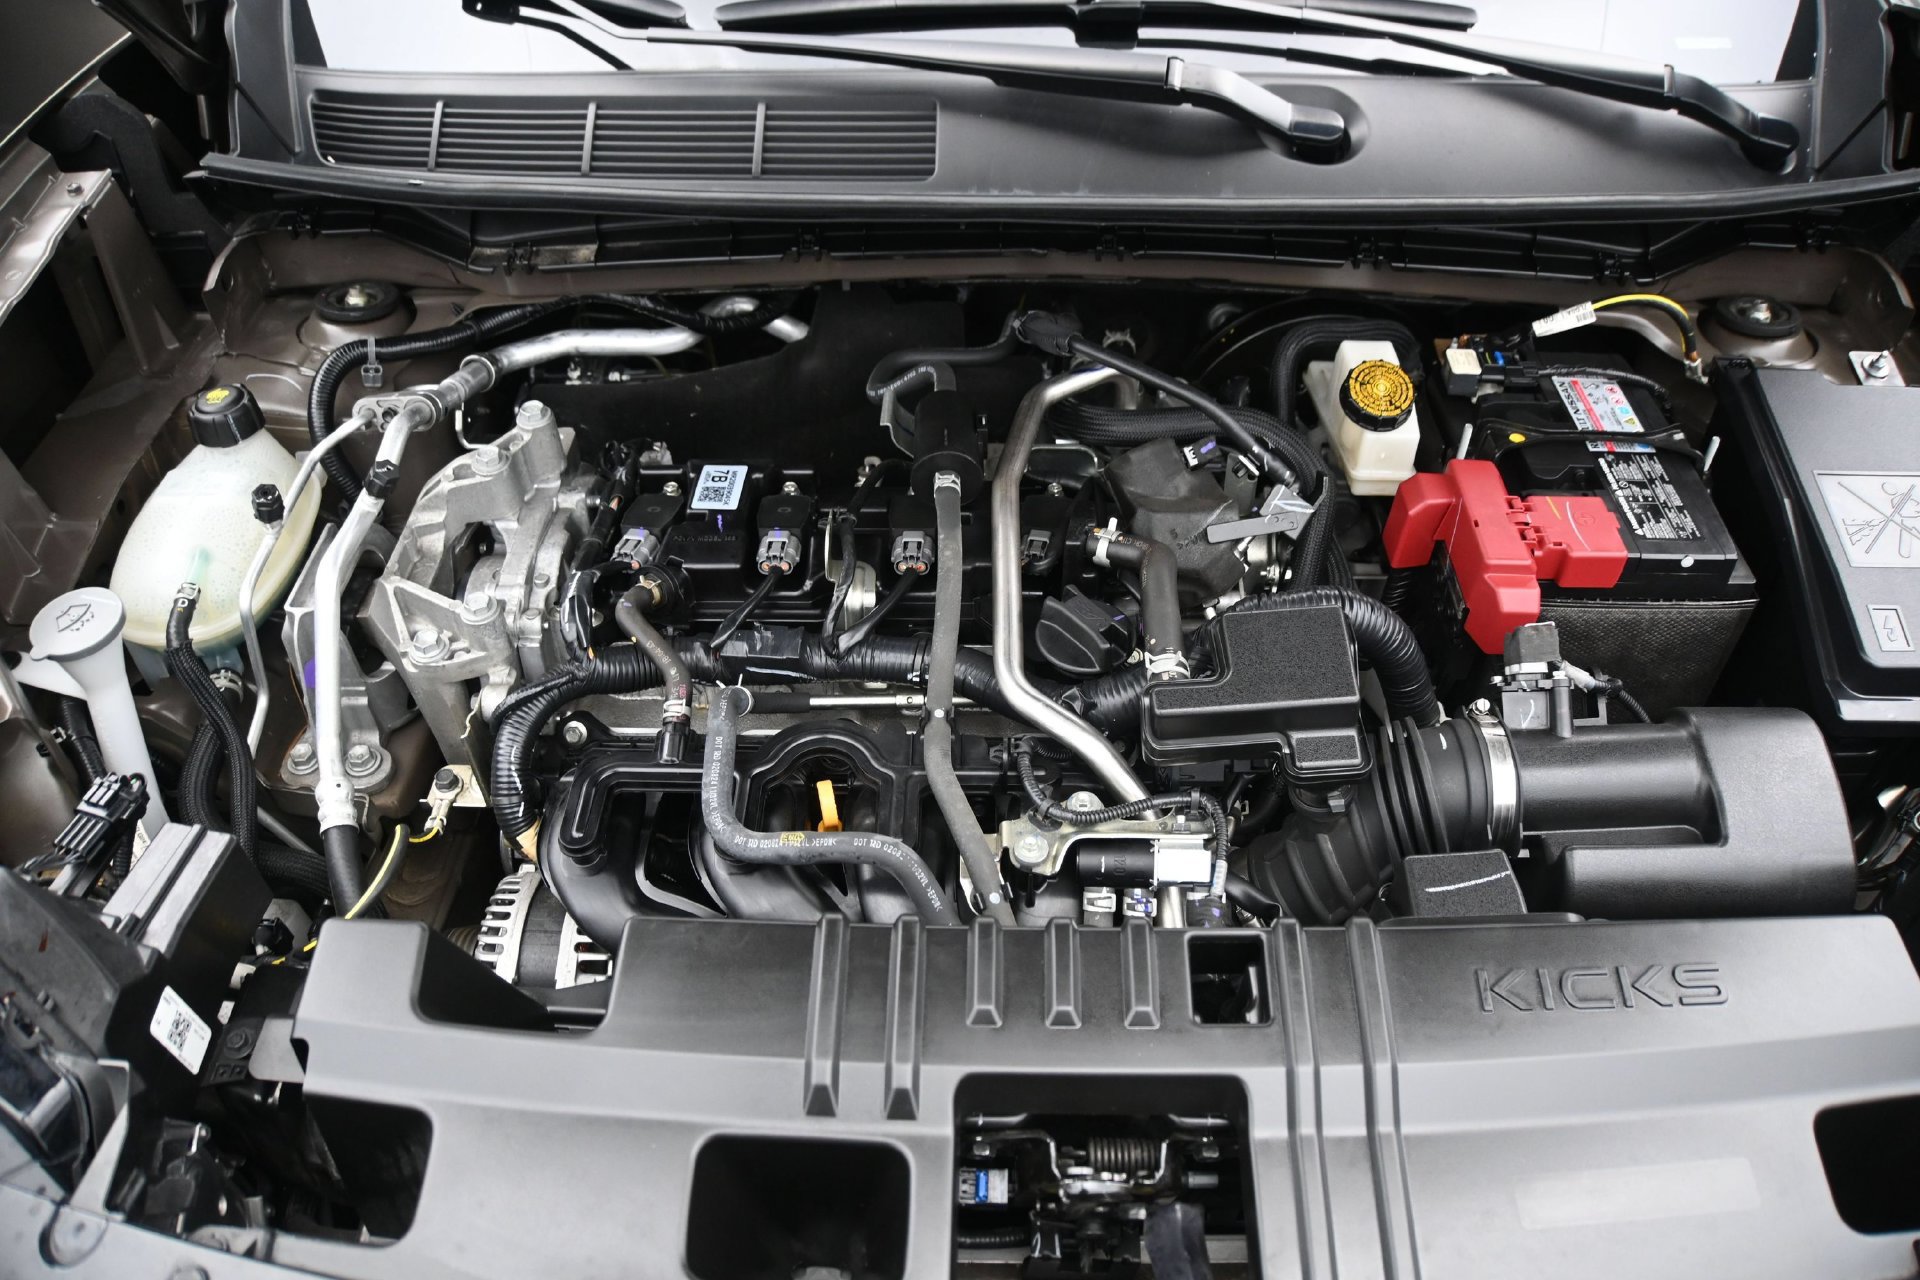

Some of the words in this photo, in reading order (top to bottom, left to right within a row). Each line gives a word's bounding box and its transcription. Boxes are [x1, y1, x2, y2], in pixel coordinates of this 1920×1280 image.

[1558, 380, 1580, 415] NISSAN
[711, 470, 730, 482] 7B
[714, 736, 723, 749] DOT
[734, 835, 746, 845] DOT
[853, 838, 868, 846] DOT
[1475, 961, 1729, 1014] KICKS
